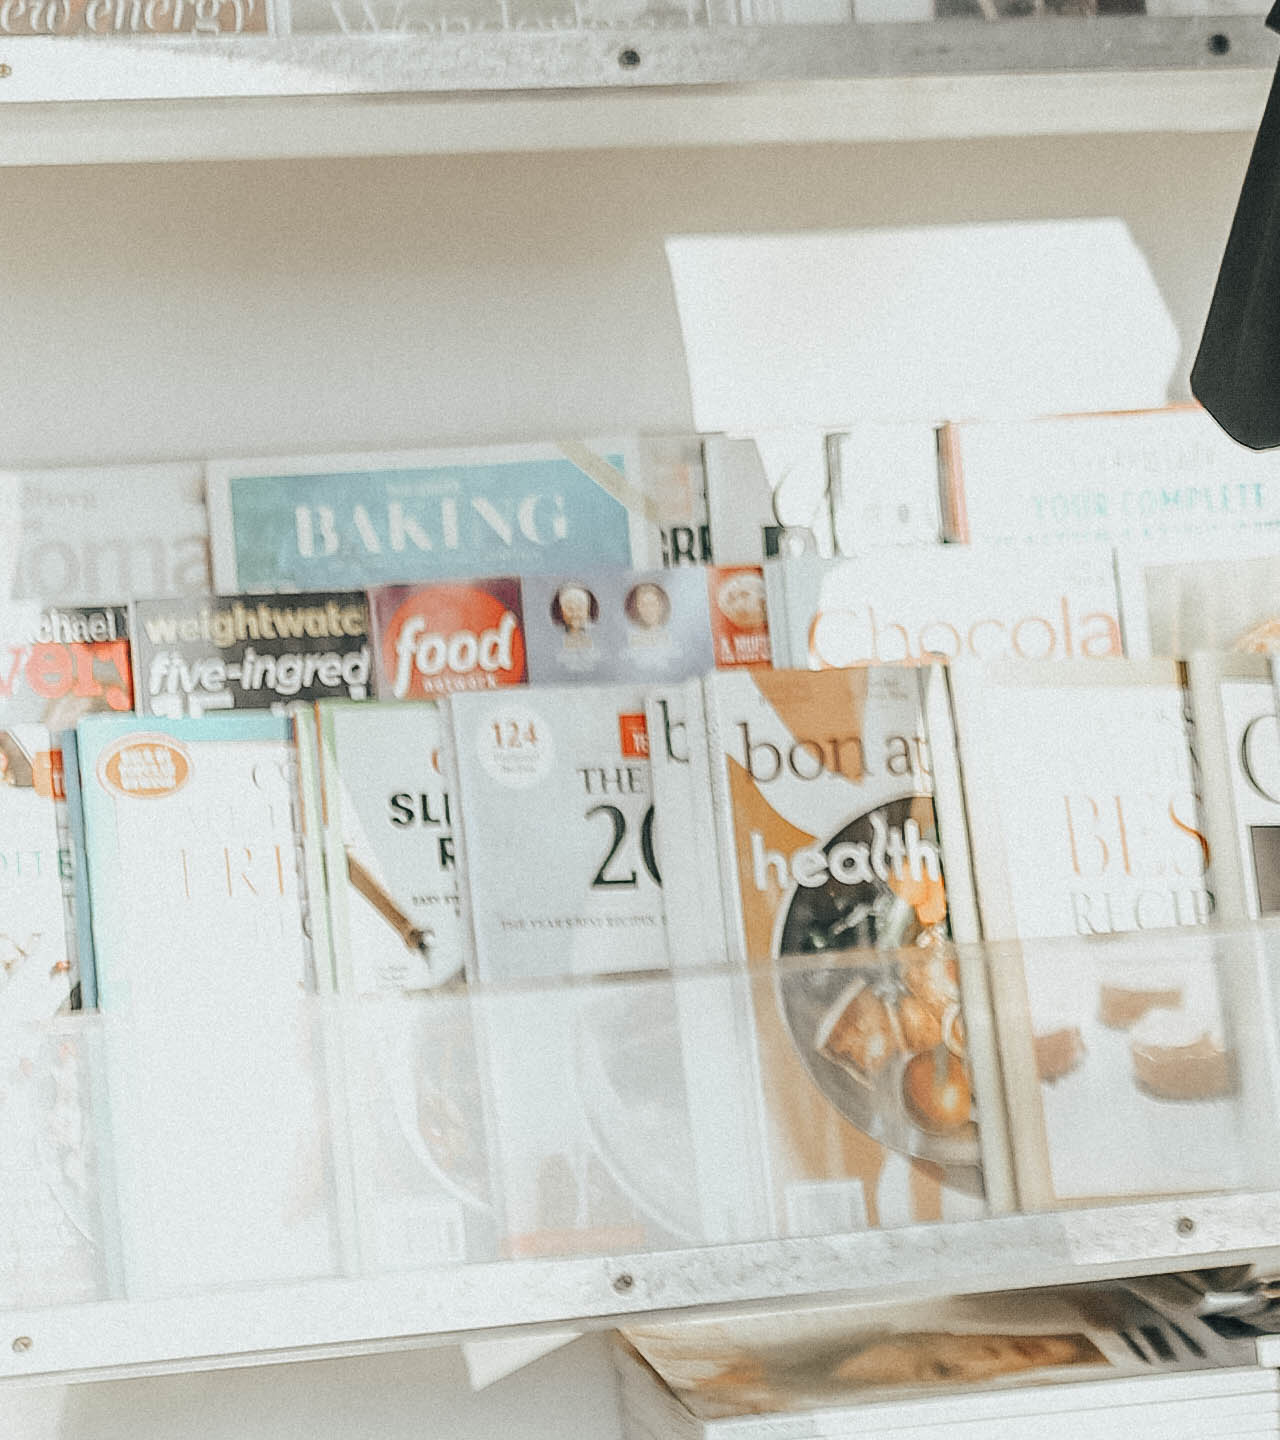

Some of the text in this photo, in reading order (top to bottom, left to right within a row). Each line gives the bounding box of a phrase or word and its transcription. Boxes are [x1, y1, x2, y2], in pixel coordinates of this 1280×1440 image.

[294, 494, 570, 558] BAKING
[392, 610, 516, 700] food
[577, 766, 648, 794] THE
[739, 724, 873, 786] bon
[752, 808, 943, 893] health
